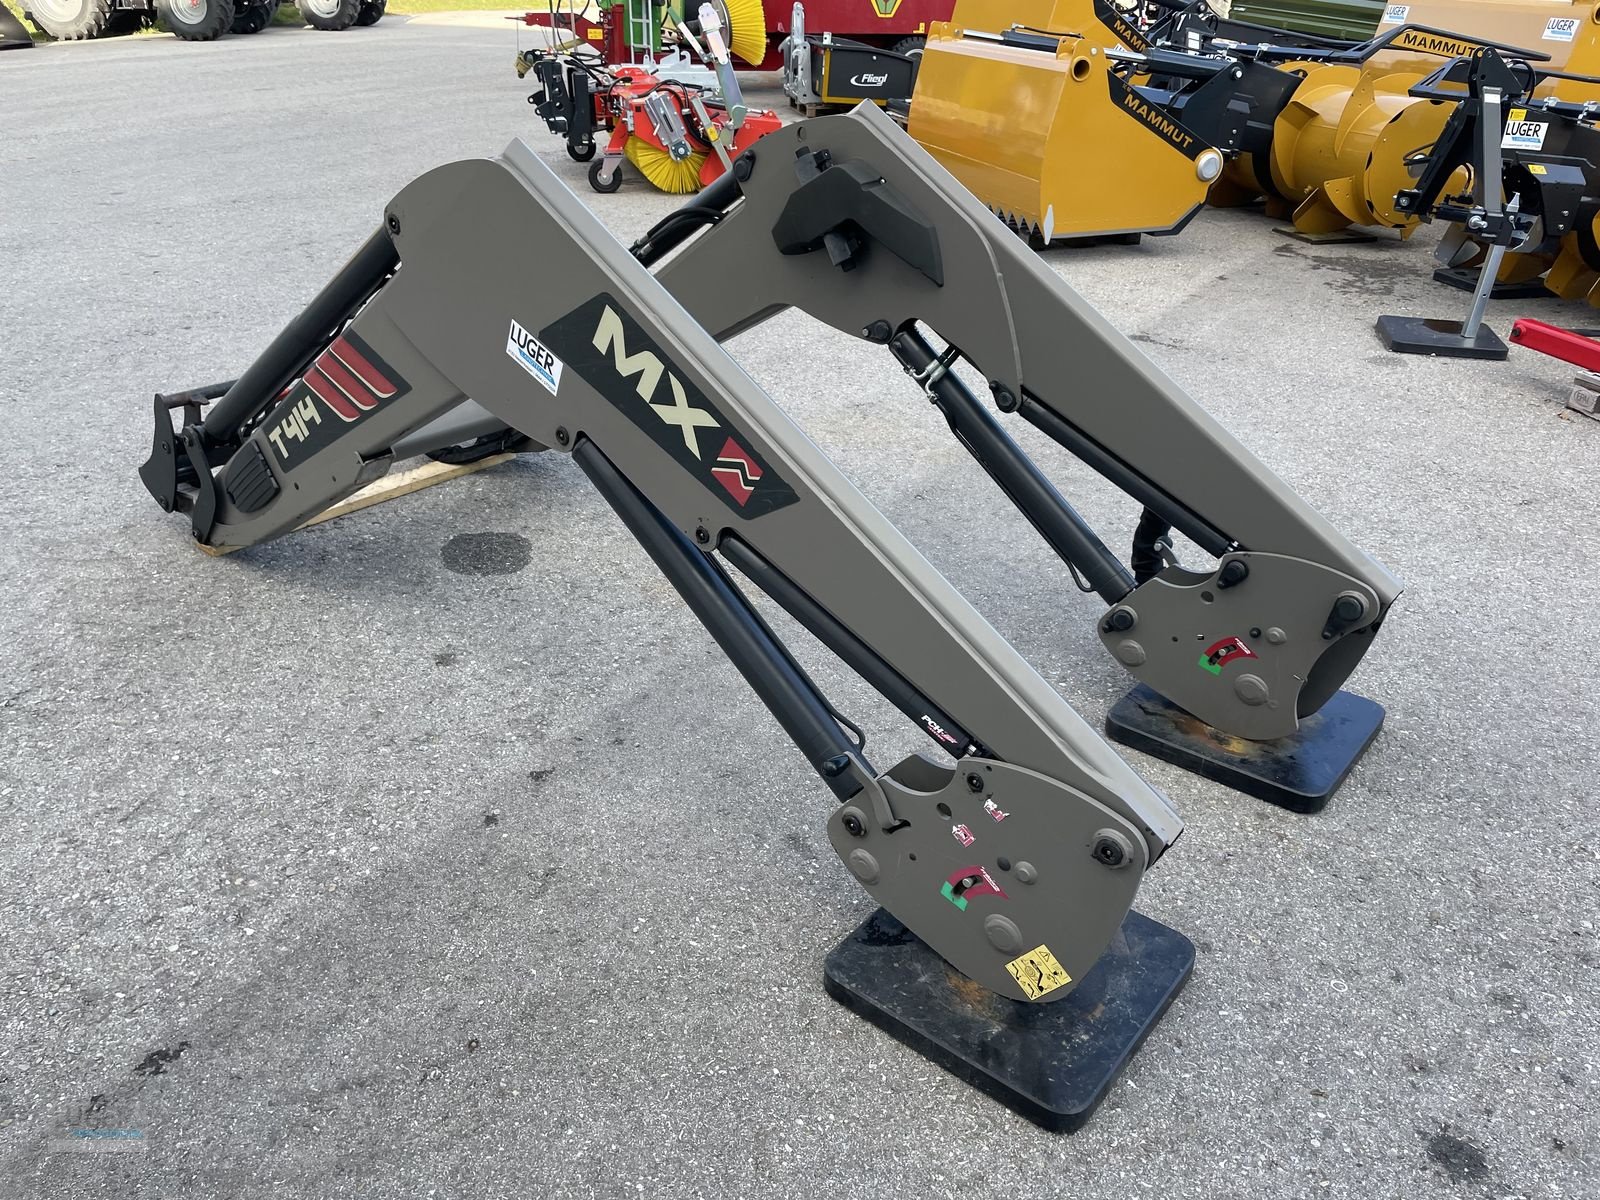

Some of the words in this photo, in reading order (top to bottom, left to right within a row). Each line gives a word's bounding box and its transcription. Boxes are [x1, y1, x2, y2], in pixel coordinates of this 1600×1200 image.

[1547, 18, 1575, 31] LUGER
[1403, 33, 1476, 58] MAMMUT
[861, 73, 888, 87] Fliegl
[1124, 93, 1193, 148] MAMMUT
[1505, 121, 1542, 138] LUGER
[510, 322, 555, 376] LUGER
[592, 304, 721, 462] MX
[268, 394, 322, 459] T414
